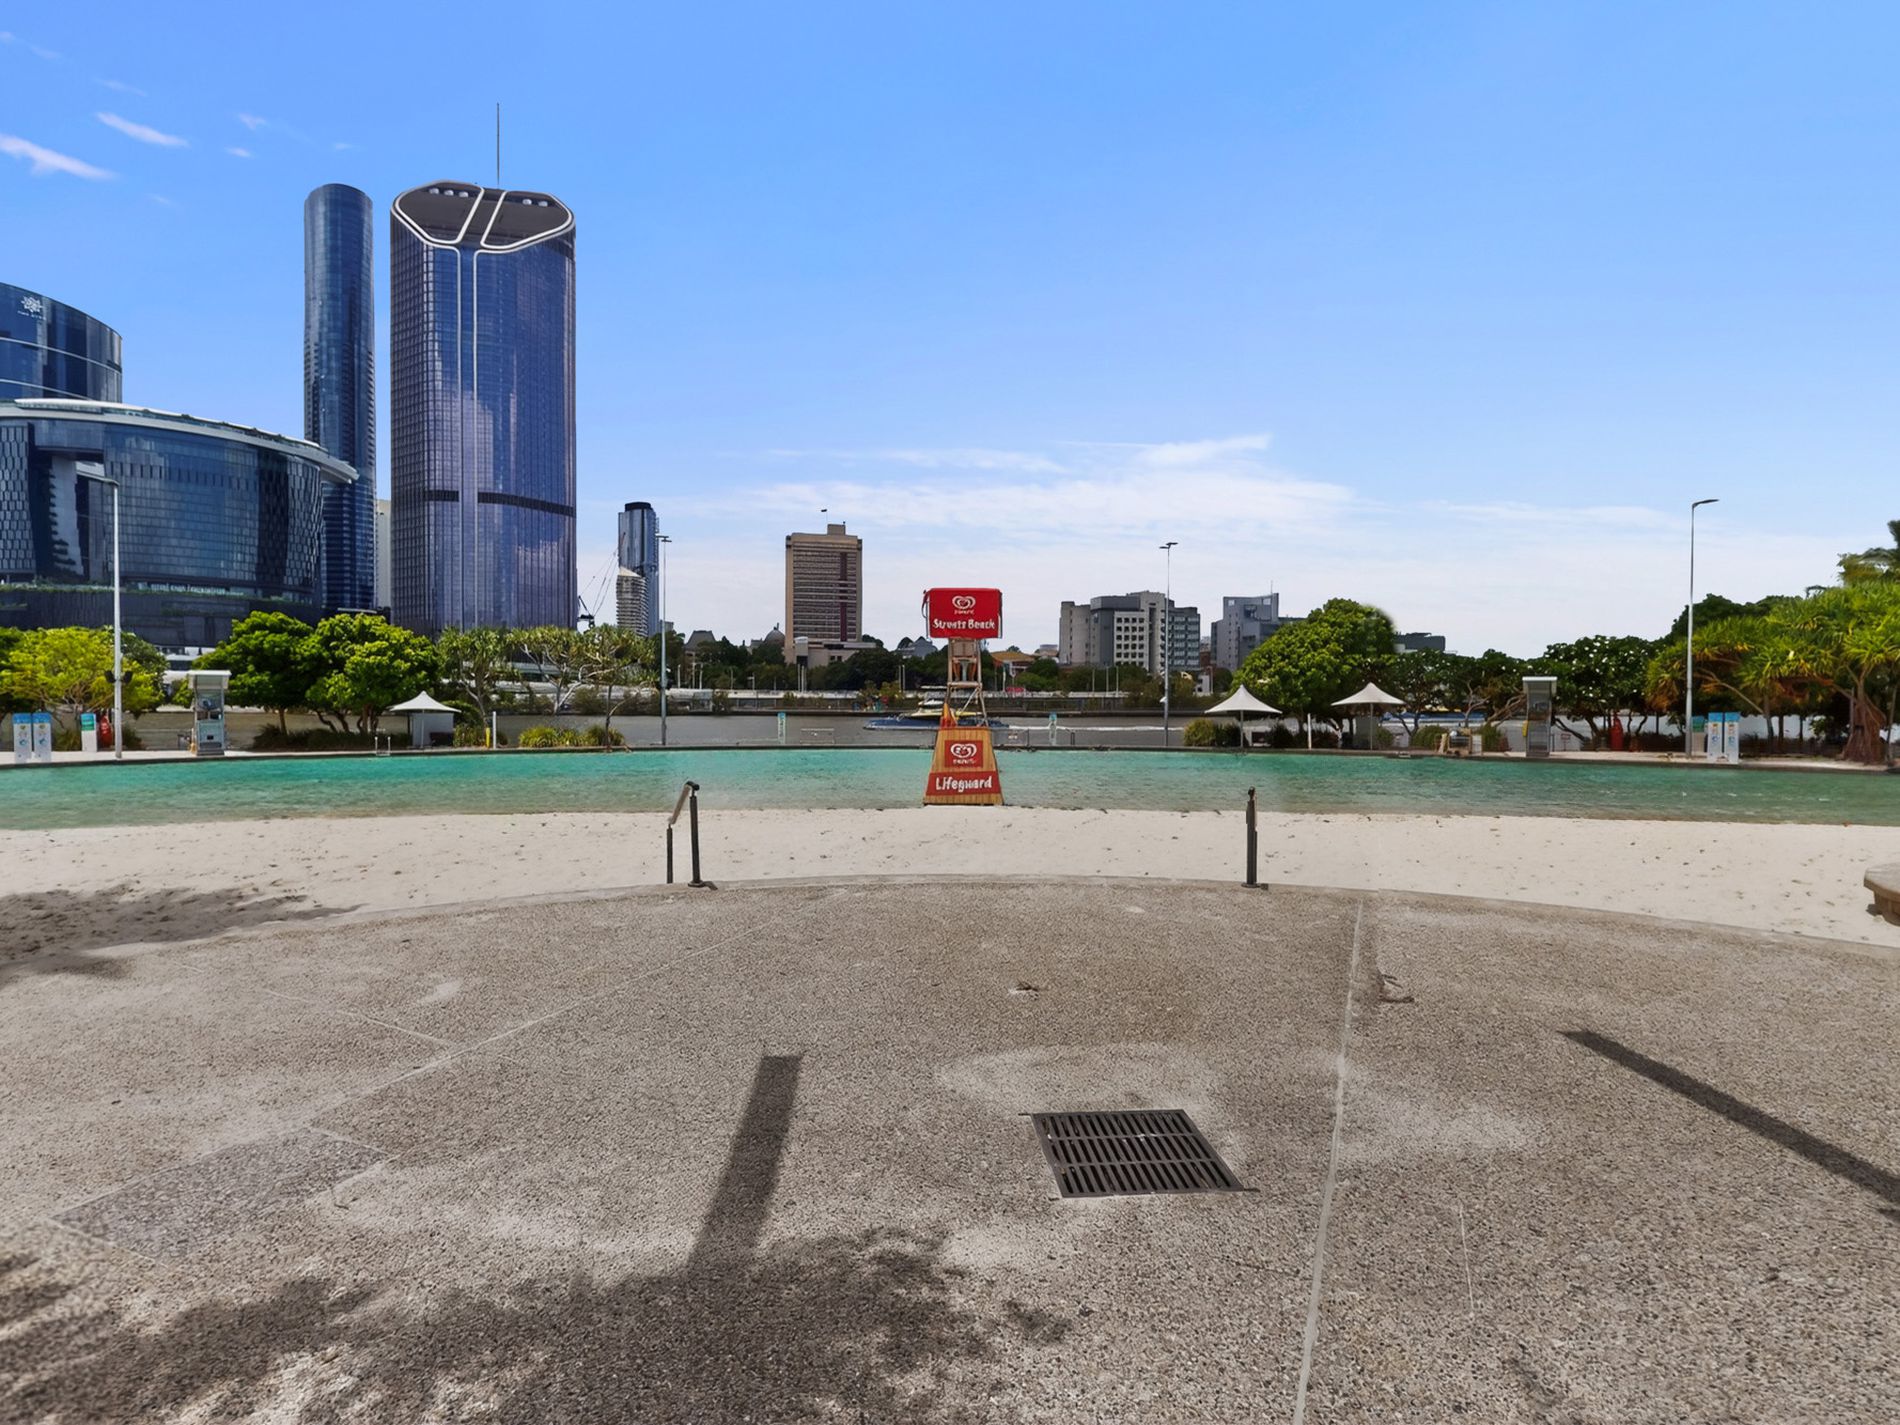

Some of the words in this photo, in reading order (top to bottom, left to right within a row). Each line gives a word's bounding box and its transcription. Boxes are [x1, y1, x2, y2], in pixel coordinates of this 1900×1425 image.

[933, 618, 966, 630] Streets
[968, 618, 996, 630] Beach
[935, 775, 993, 793] Lifeguard
